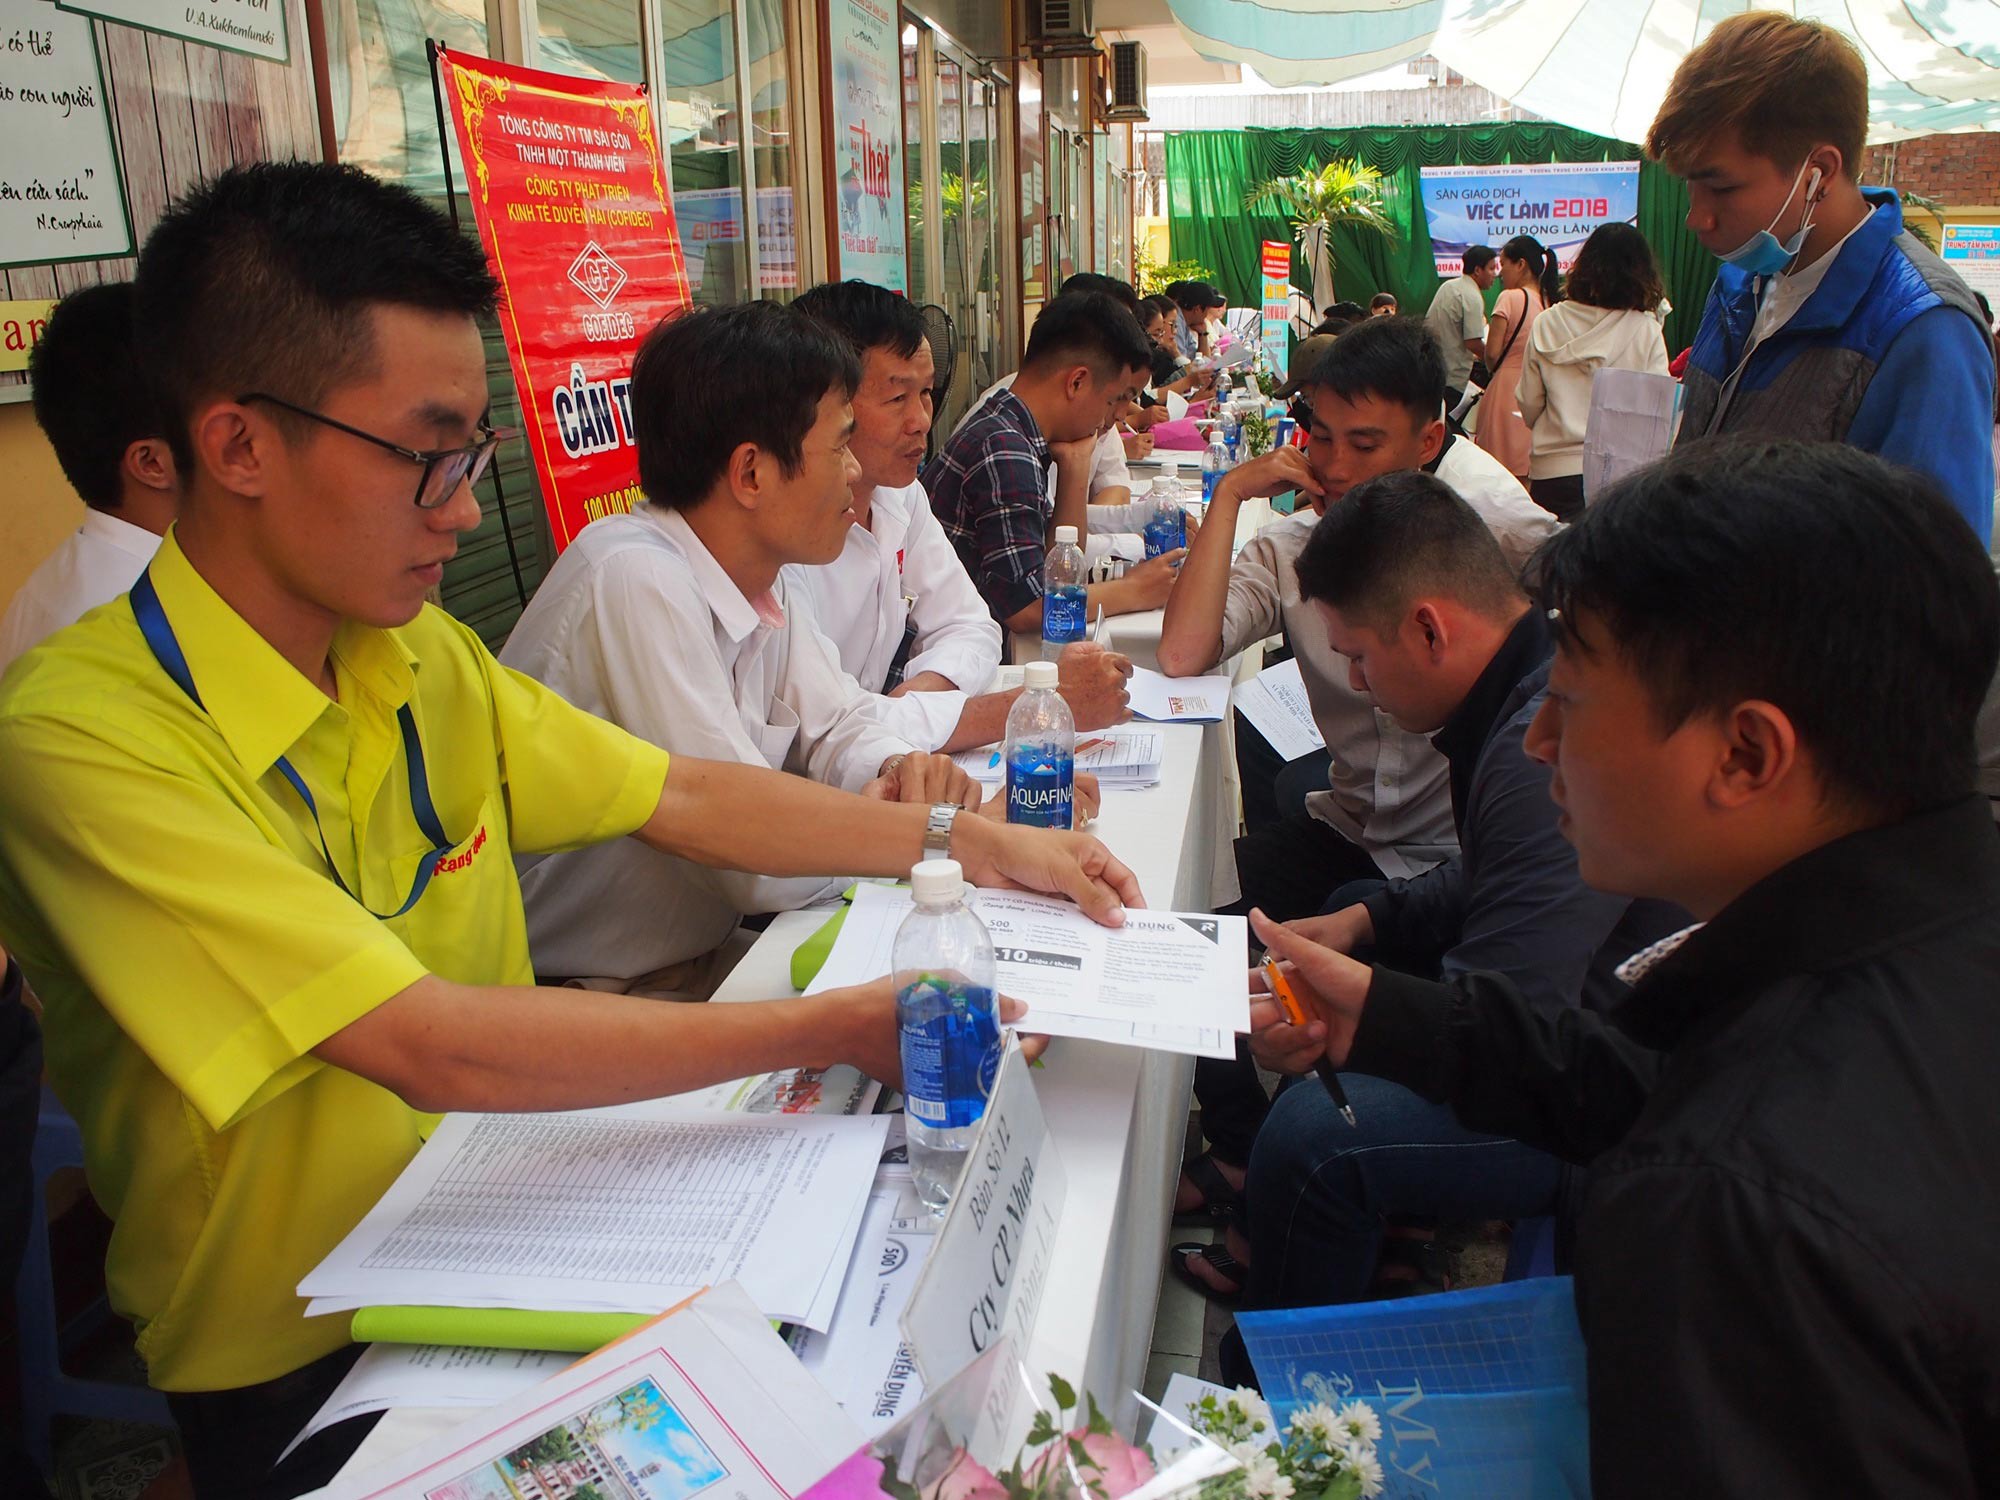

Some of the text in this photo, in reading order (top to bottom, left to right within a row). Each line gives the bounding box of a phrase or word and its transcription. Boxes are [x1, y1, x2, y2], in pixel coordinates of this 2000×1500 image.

[27, 30, 54, 56] thể
[20, 88, 48, 104] con
[52, 85, 96, 118] người
[532, 117, 563, 141] CÔNG
[563, 125, 577, 143] TY
[578, 127, 594, 145] TM
[593, 126, 611, 147] SÀI
[610, 129, 632, 150] GÒN
[516, 143, 626, 173] TNHH MỘT THÀNH VIÊN
[526, 173, 559, 197] CÔNG
[559, 179, 573, 198] TY
[575, 179, 601, 200] PHÁT
[1435, 188, 1521, 200] SÀN GIAO DỊCH
[507, 203, 536, 222] KINH
[552, 202, 589, 224] DUYÊN
[607, 209, 654, 231] (COFIDEC)
[1466, 198, 1609, 224] VIỆC LÀM 2018
[582, 311, 635, 342] COFIDEC
[553, 363, 619, 459] CẦN
[1010, 783, 1073, 809] AQUAFINA
[989, 920, 1010, 928] 500
[880, 1247, 900, 1267] 500
[970, 1283, 998, 1353] Cty
[992, 1224, 1012, 1288] CP
